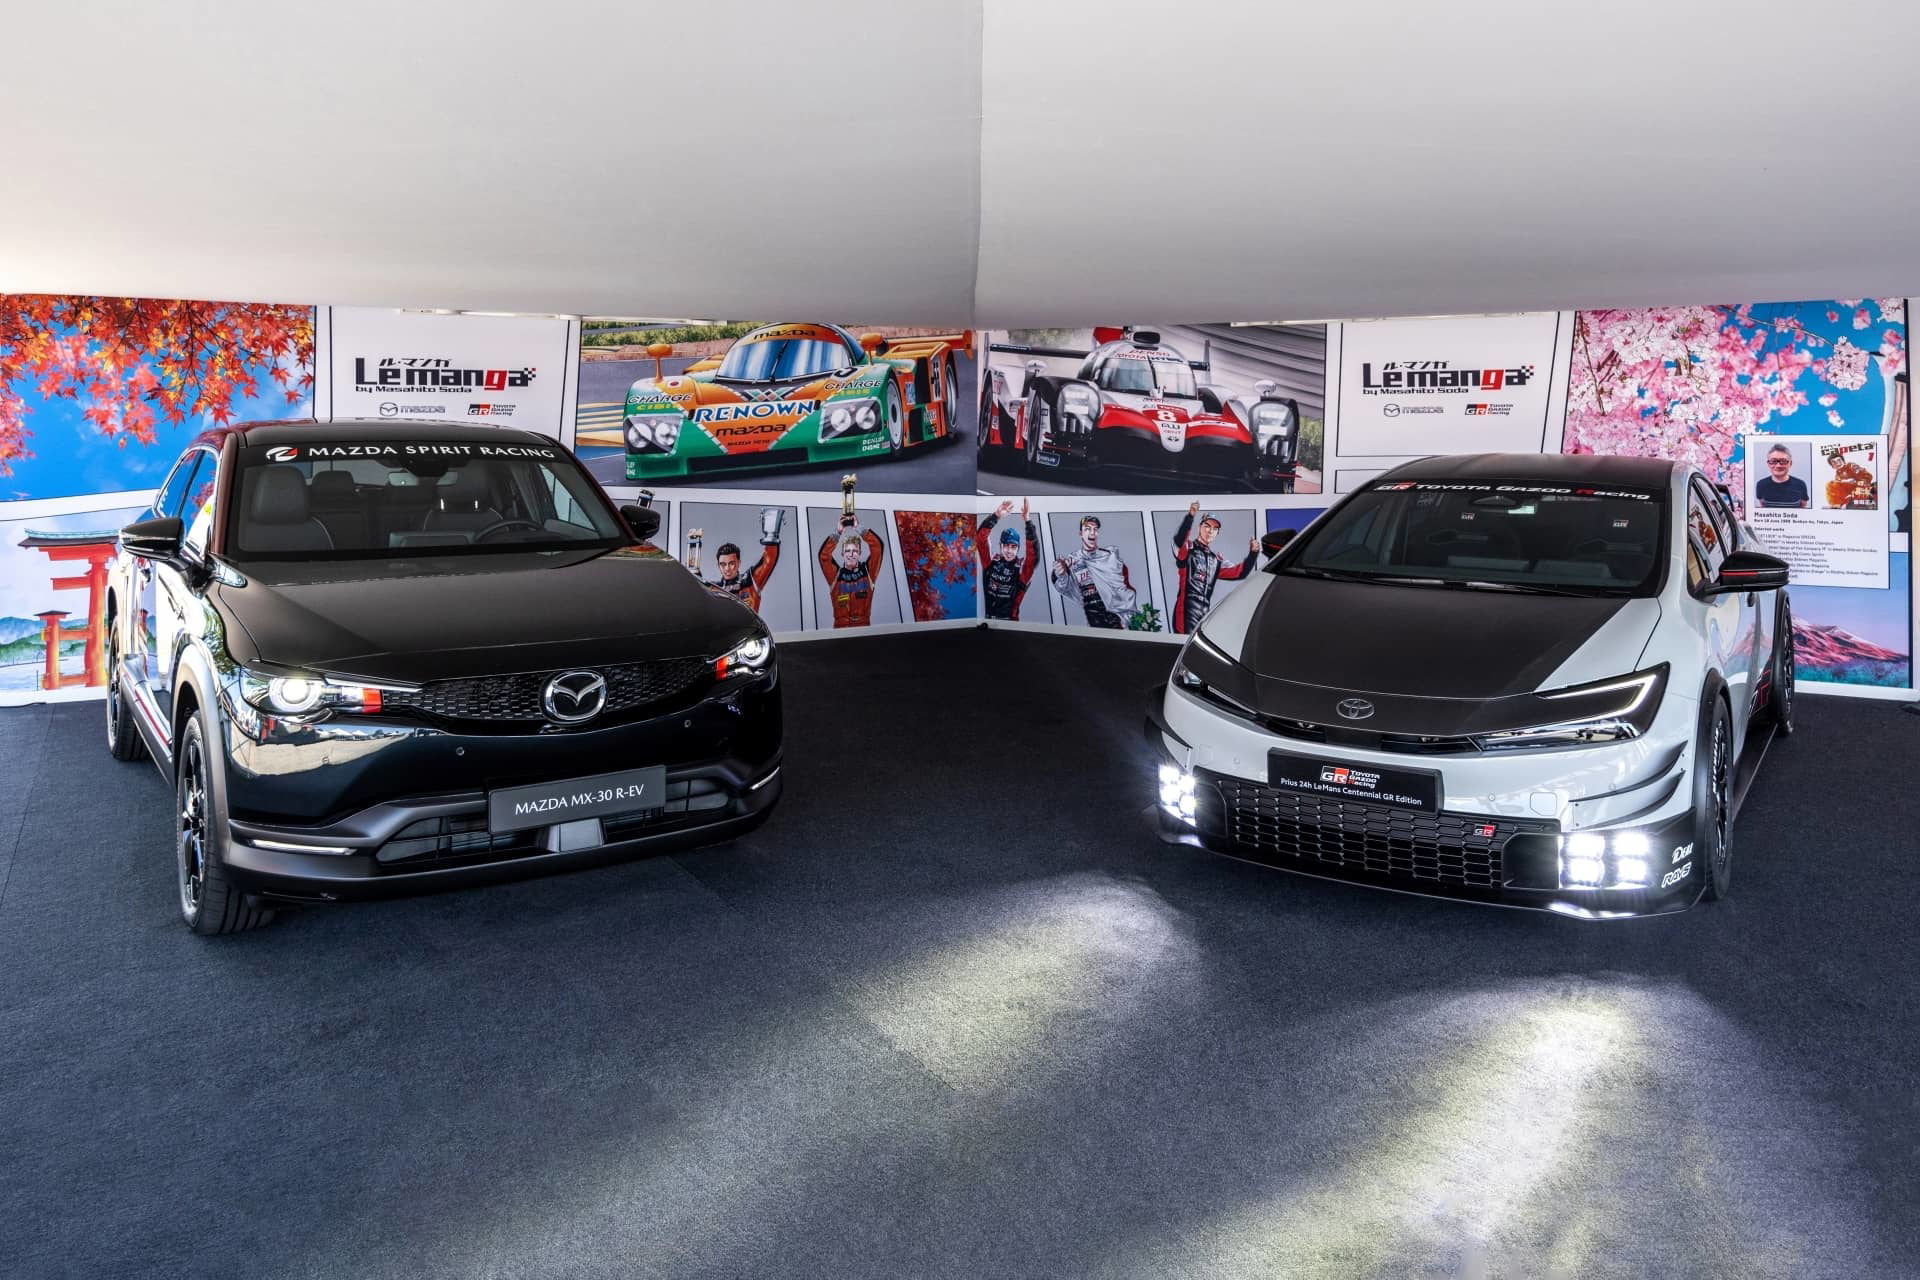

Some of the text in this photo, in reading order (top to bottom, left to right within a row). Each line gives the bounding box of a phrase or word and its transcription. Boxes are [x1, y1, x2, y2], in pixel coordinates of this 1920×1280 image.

[824, 380, 881, 390] CHARGE
[628, 393, 693, 404] CHARGE
[468, 405, 490, 415] GR
[694, 400, 814, 422] RENOWN
[1157, 410, 1177, 421] 8
[1465, 405, 1487, 415] GR
[715, 423, 787, 437] mazda
[308, 445, 555, 458] MAZDA SPIRIT RACING
[1496, 485, 1571, 493] GAZOO
[1575, 488, 1650, 500] Racing
[1321, 768, 1349, 784] GR
[1349, 775, 1377, 783] GAZOO
[1350, 770, 1380, 779] TOYOTA
[1348, 779, 1375, 788] Racing
[1281, 777, 1298, 787] Prius
[1299, 781, 1313, 789] 24h
[1342, 787, 1381, 799] Centennial
[1382, 793, 1395, 801] GR
[1396, 795, 1422, 806] Edition
[515, 783, 645, 815] MAZDA MX-30 R-EV
[1473, 825, 1495, 837] GR
[1661, 861, 1692, 888] RAYS
